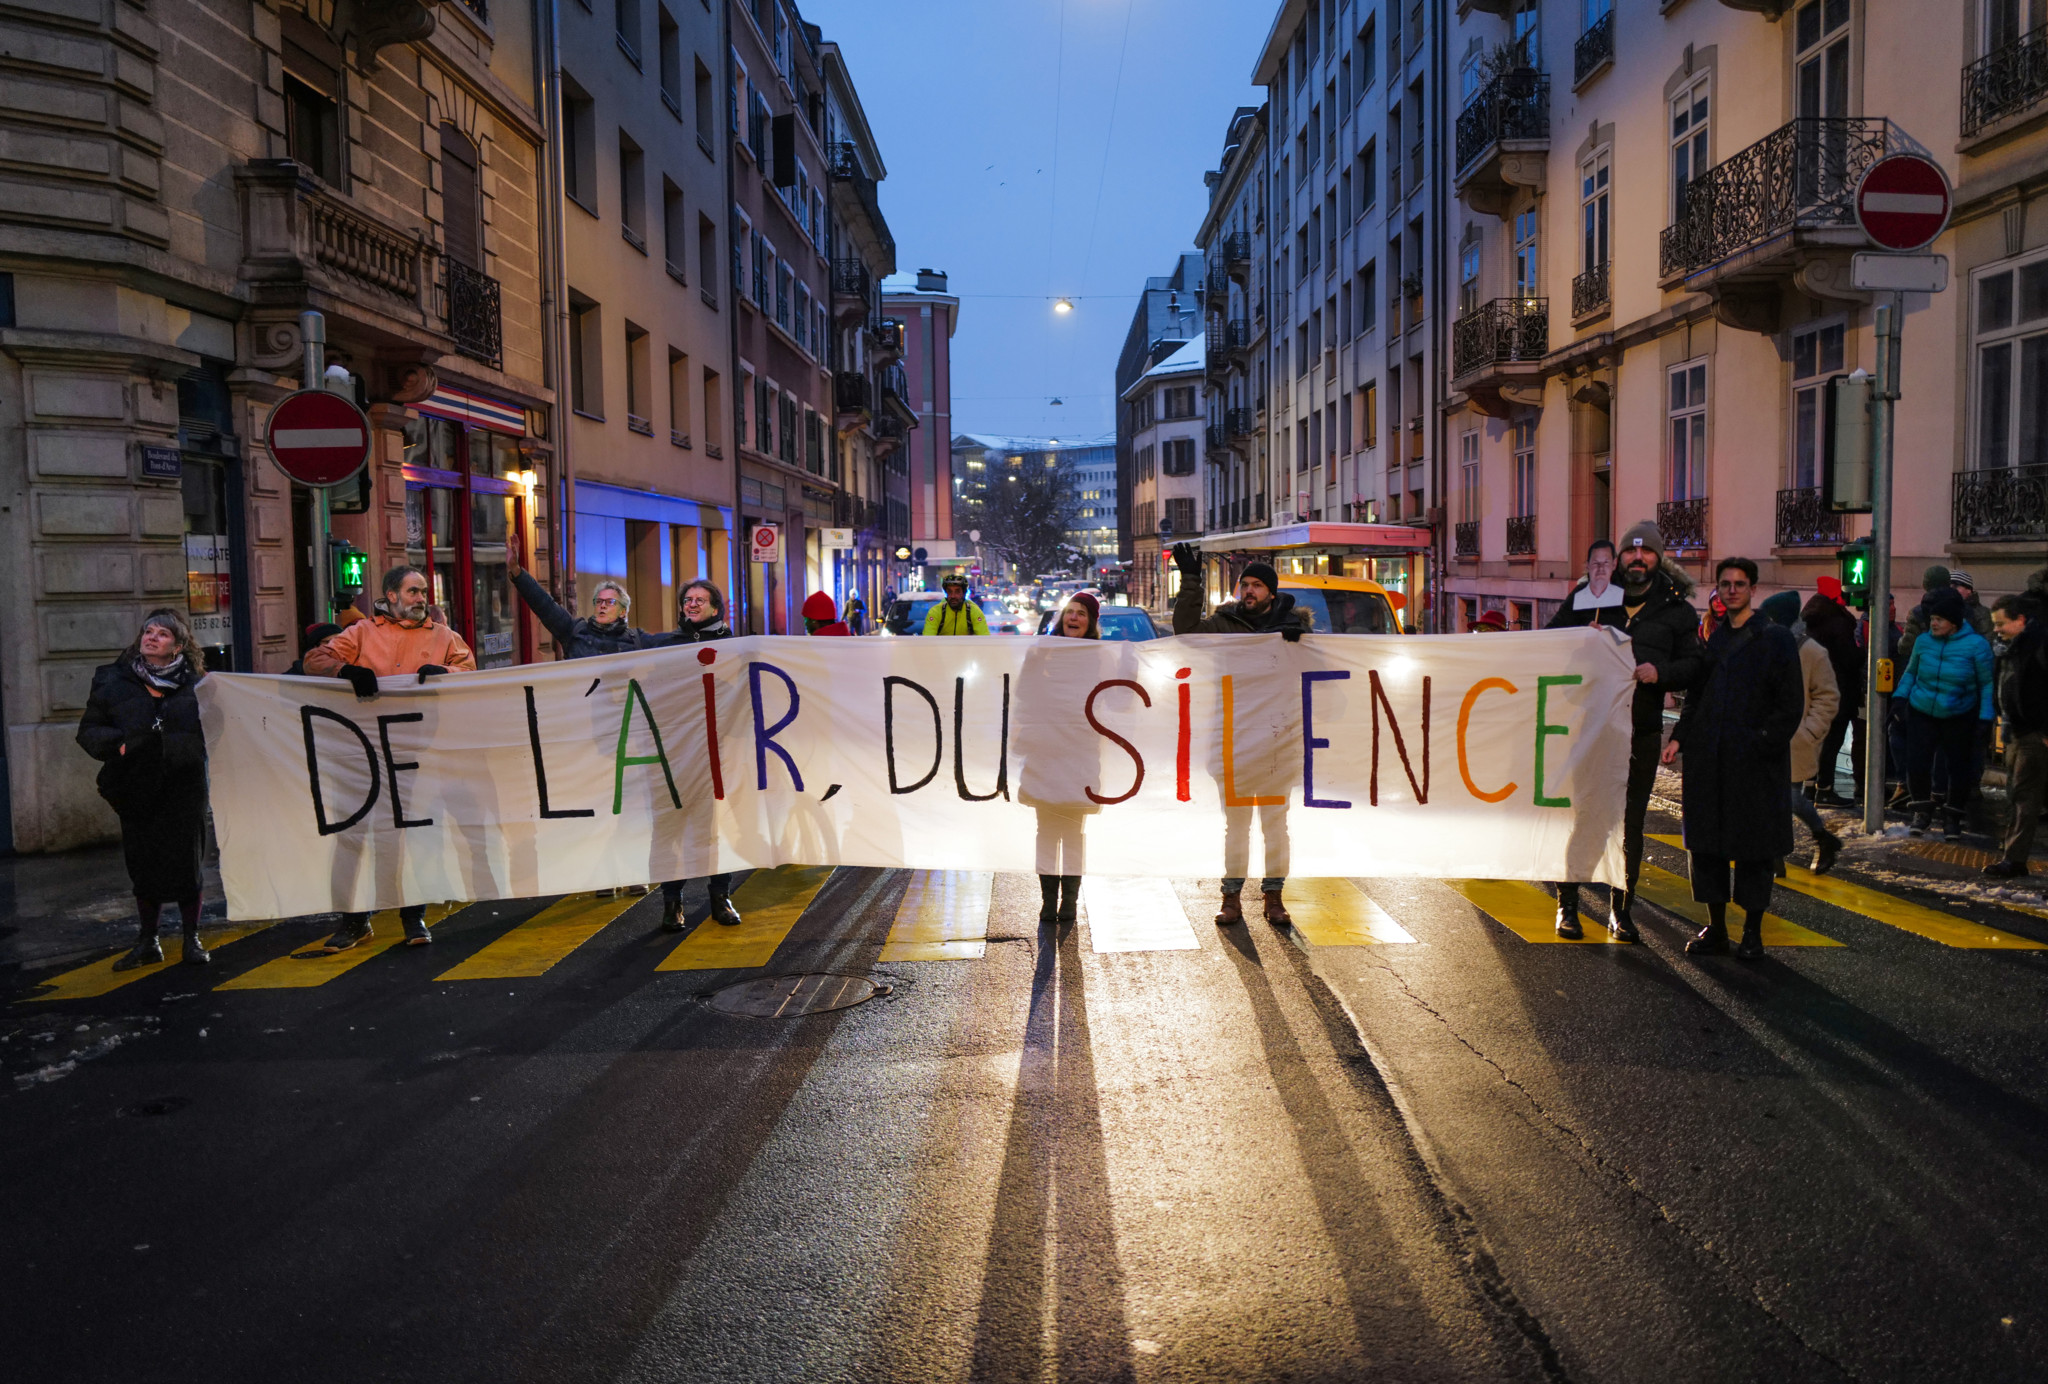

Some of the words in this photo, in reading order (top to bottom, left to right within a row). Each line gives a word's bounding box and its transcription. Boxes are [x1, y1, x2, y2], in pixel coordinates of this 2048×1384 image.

[147, 450, 170, 461] Boulevard
[189, 547, 230, 561] ANSGATE
[189, 581, 230, 596] EMETTRE
[222, 616, 231, 628] 62
[300, 704, 434, 836] DE
[883, 673, 1010, 802] DU
